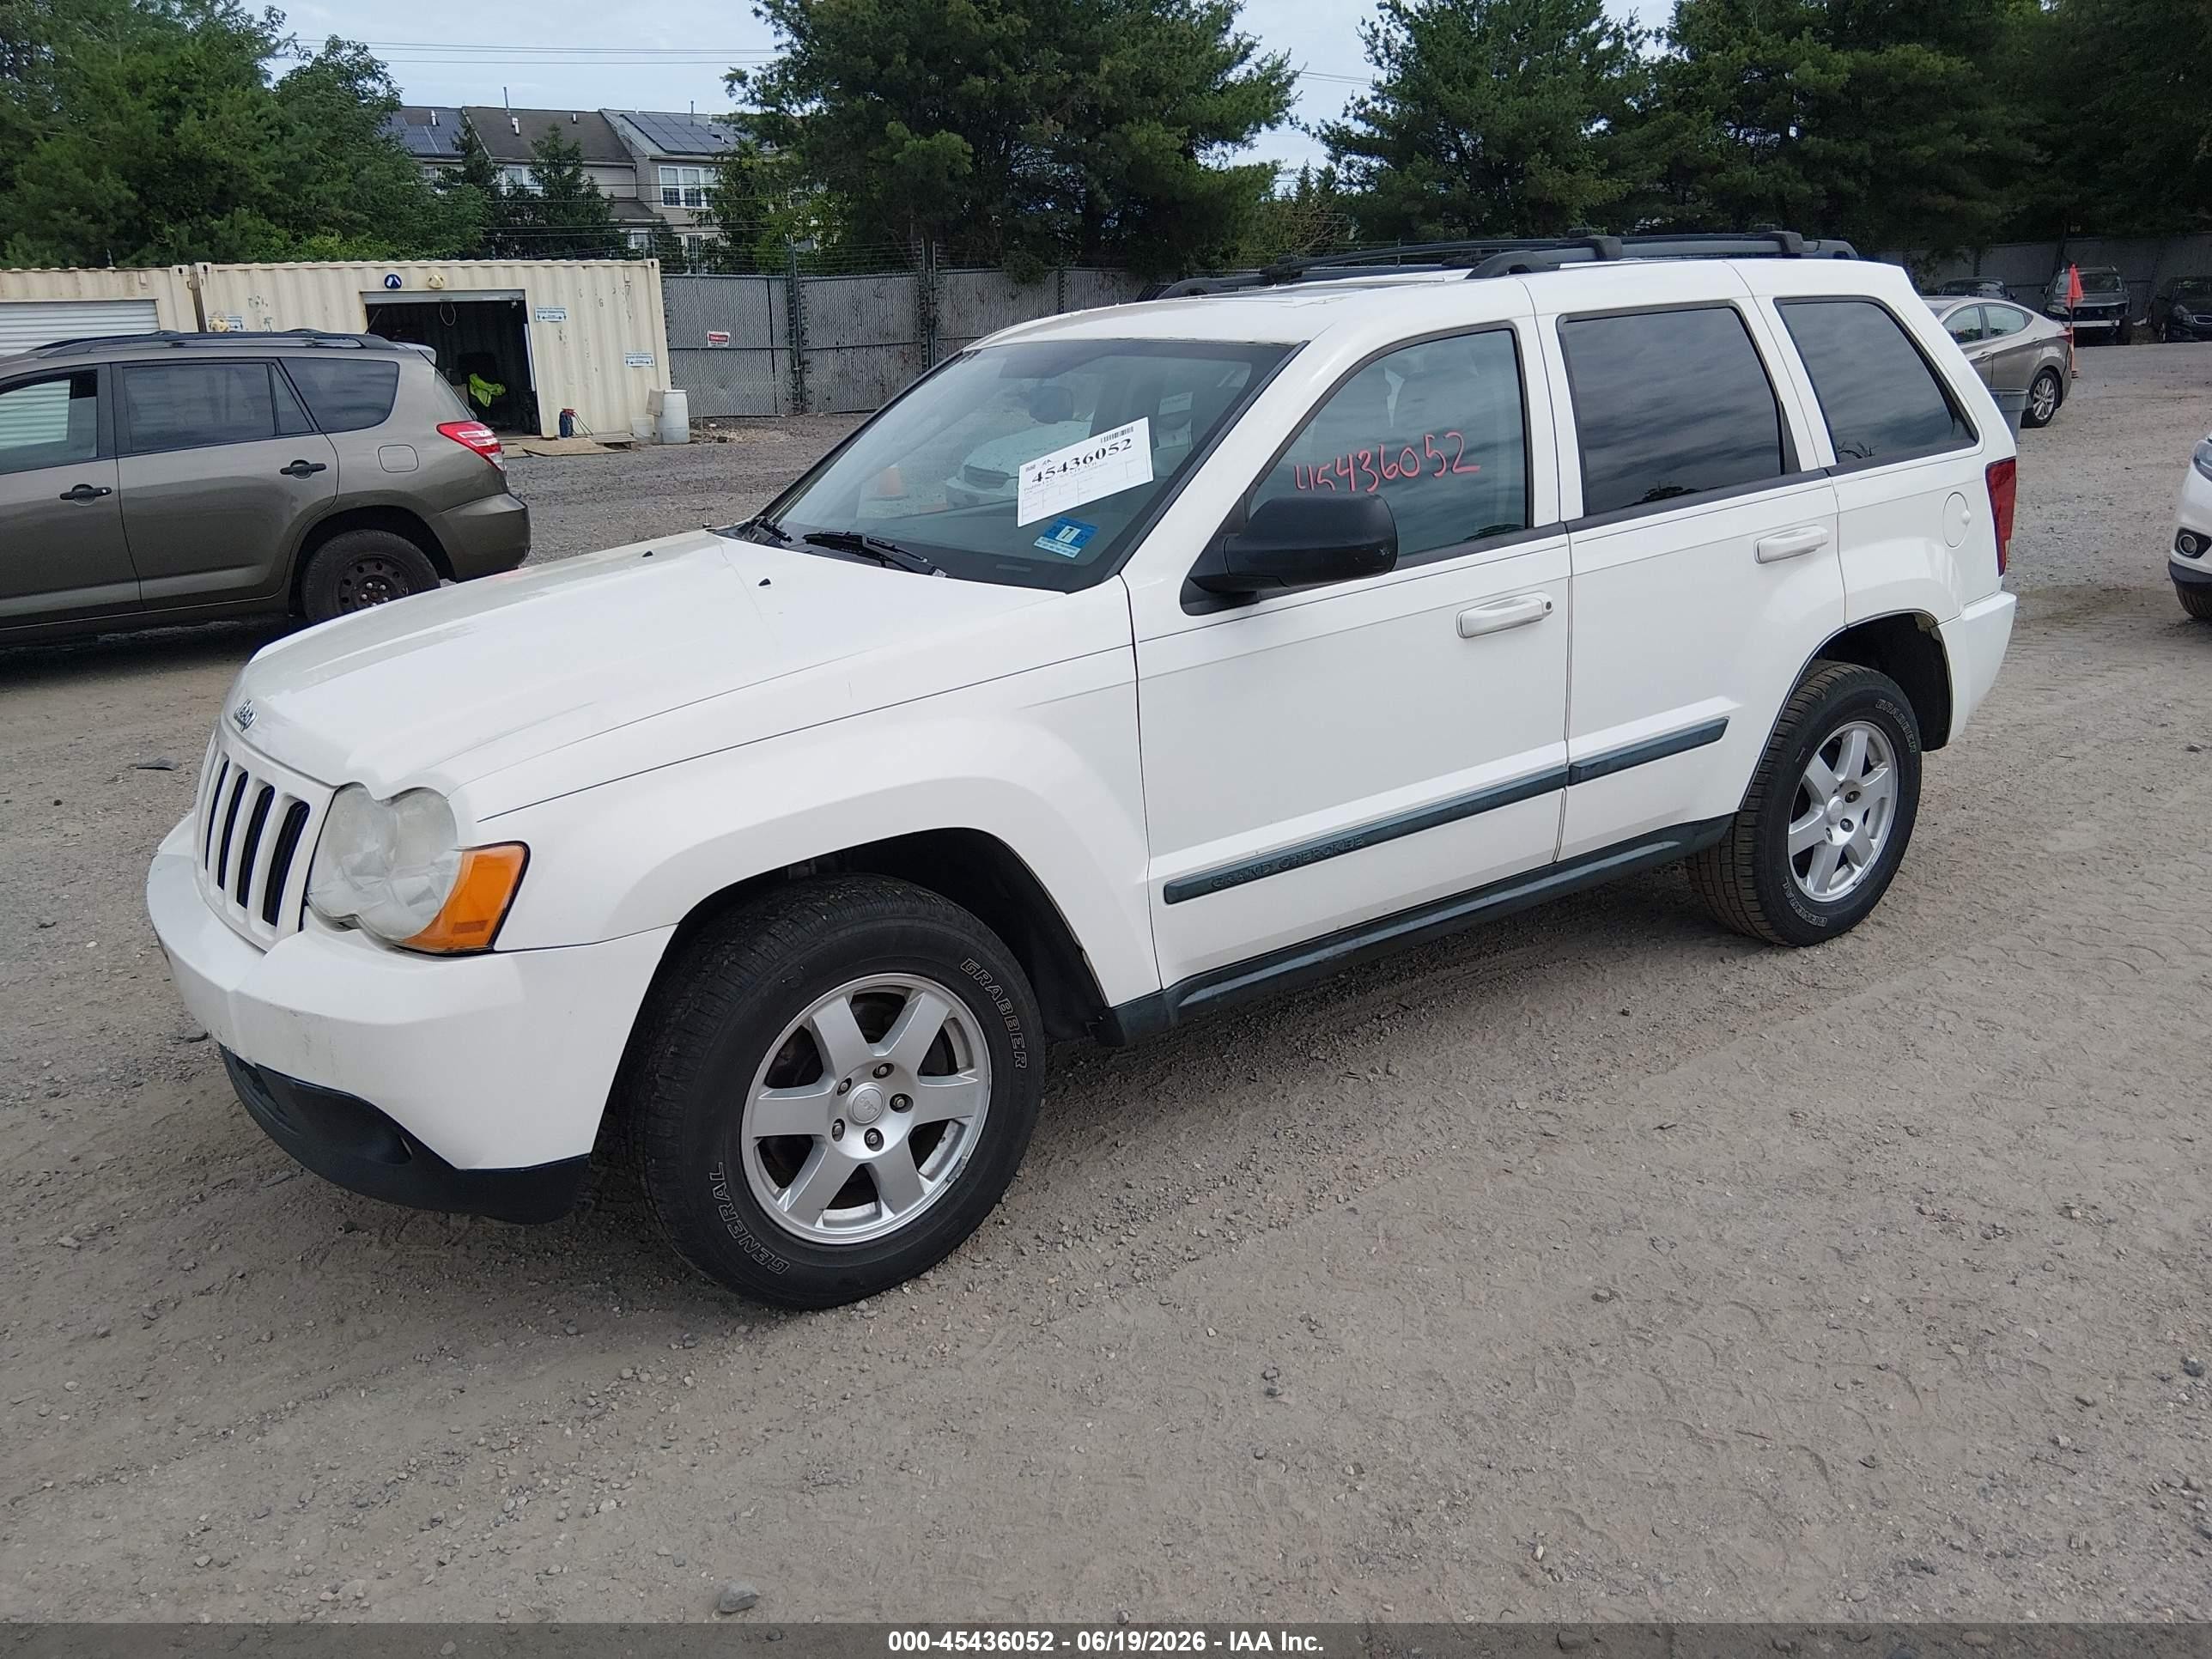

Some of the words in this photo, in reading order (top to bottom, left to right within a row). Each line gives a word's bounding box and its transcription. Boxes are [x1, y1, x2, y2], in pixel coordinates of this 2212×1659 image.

[1031, 438, 1133, 483] 45436052
[1294, 432, 1480, 492] 45436052
[1211, 863, 1271, 888] GRAND
[1277, 836, 1364, 870] CHEROKEE
[960, 957, 1028, 1068] GRABBER
[709, 1161, 790, 1274] GENERAL
